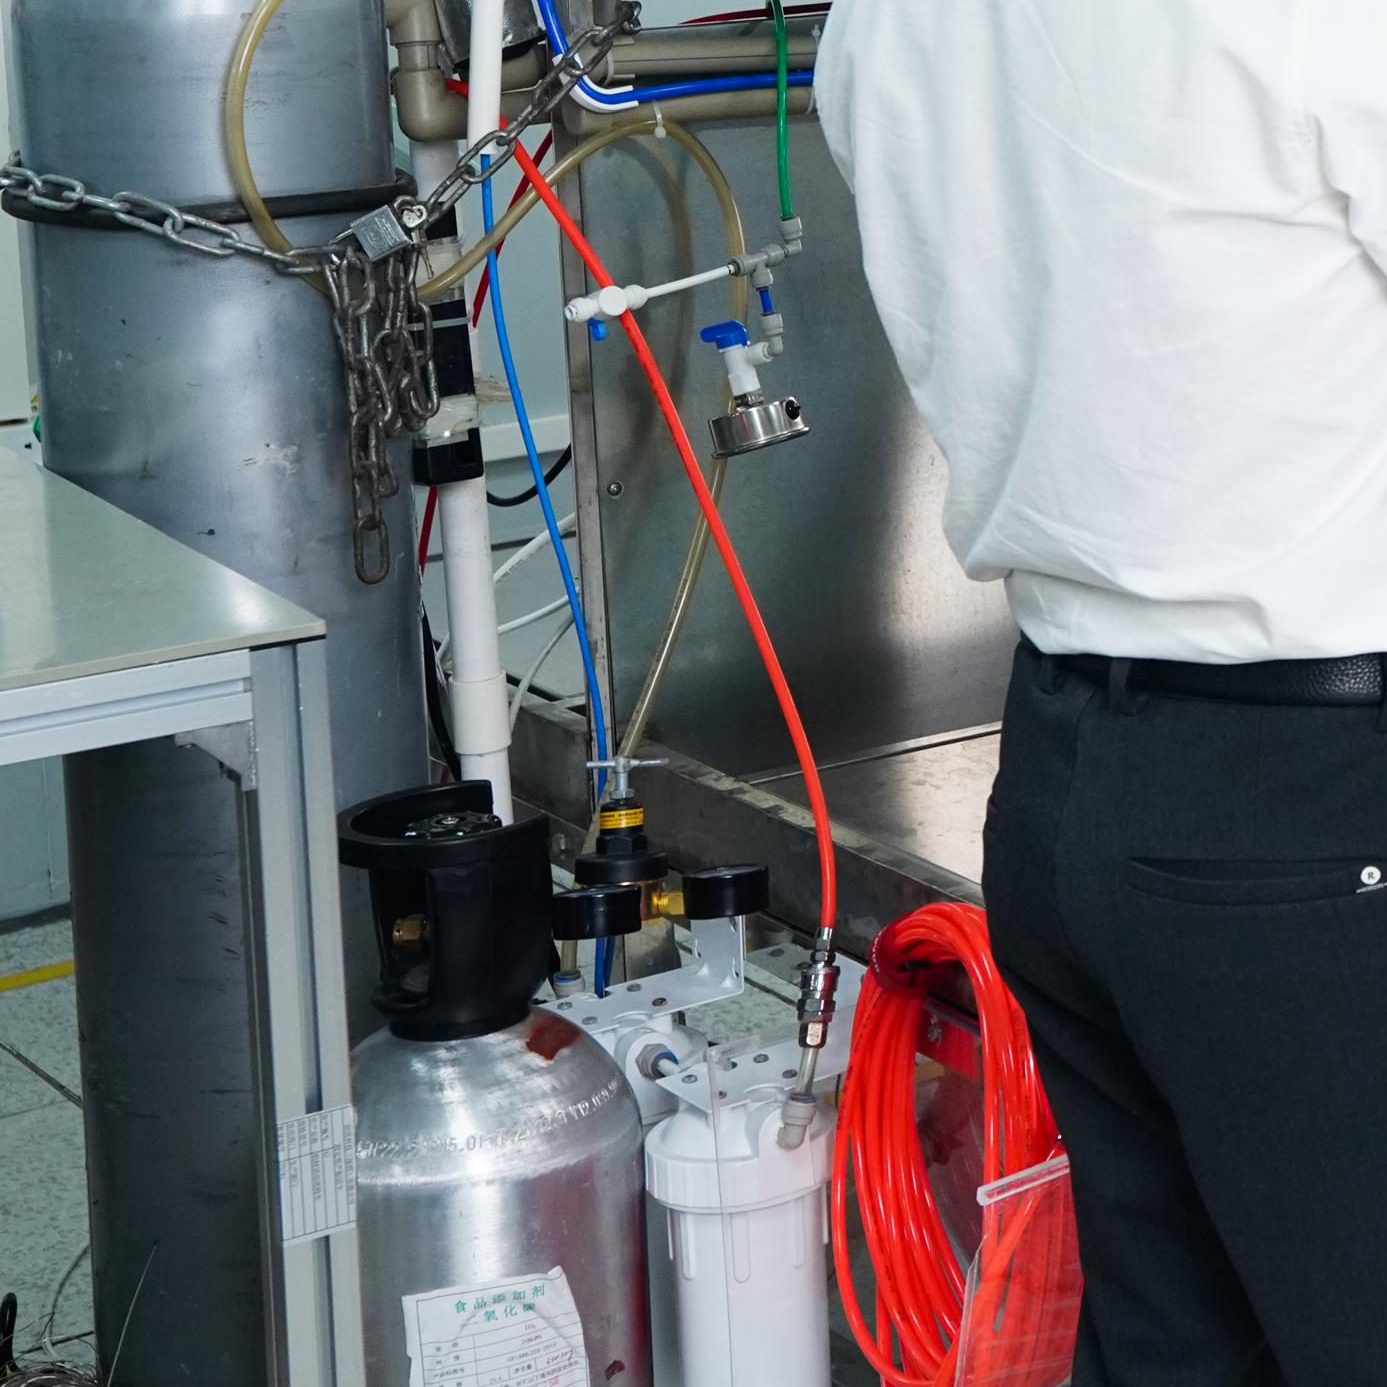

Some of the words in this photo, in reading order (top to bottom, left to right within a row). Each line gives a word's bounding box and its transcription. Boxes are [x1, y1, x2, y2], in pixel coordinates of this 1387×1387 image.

[454, 1284, 544, 1314] 食品添加剂
